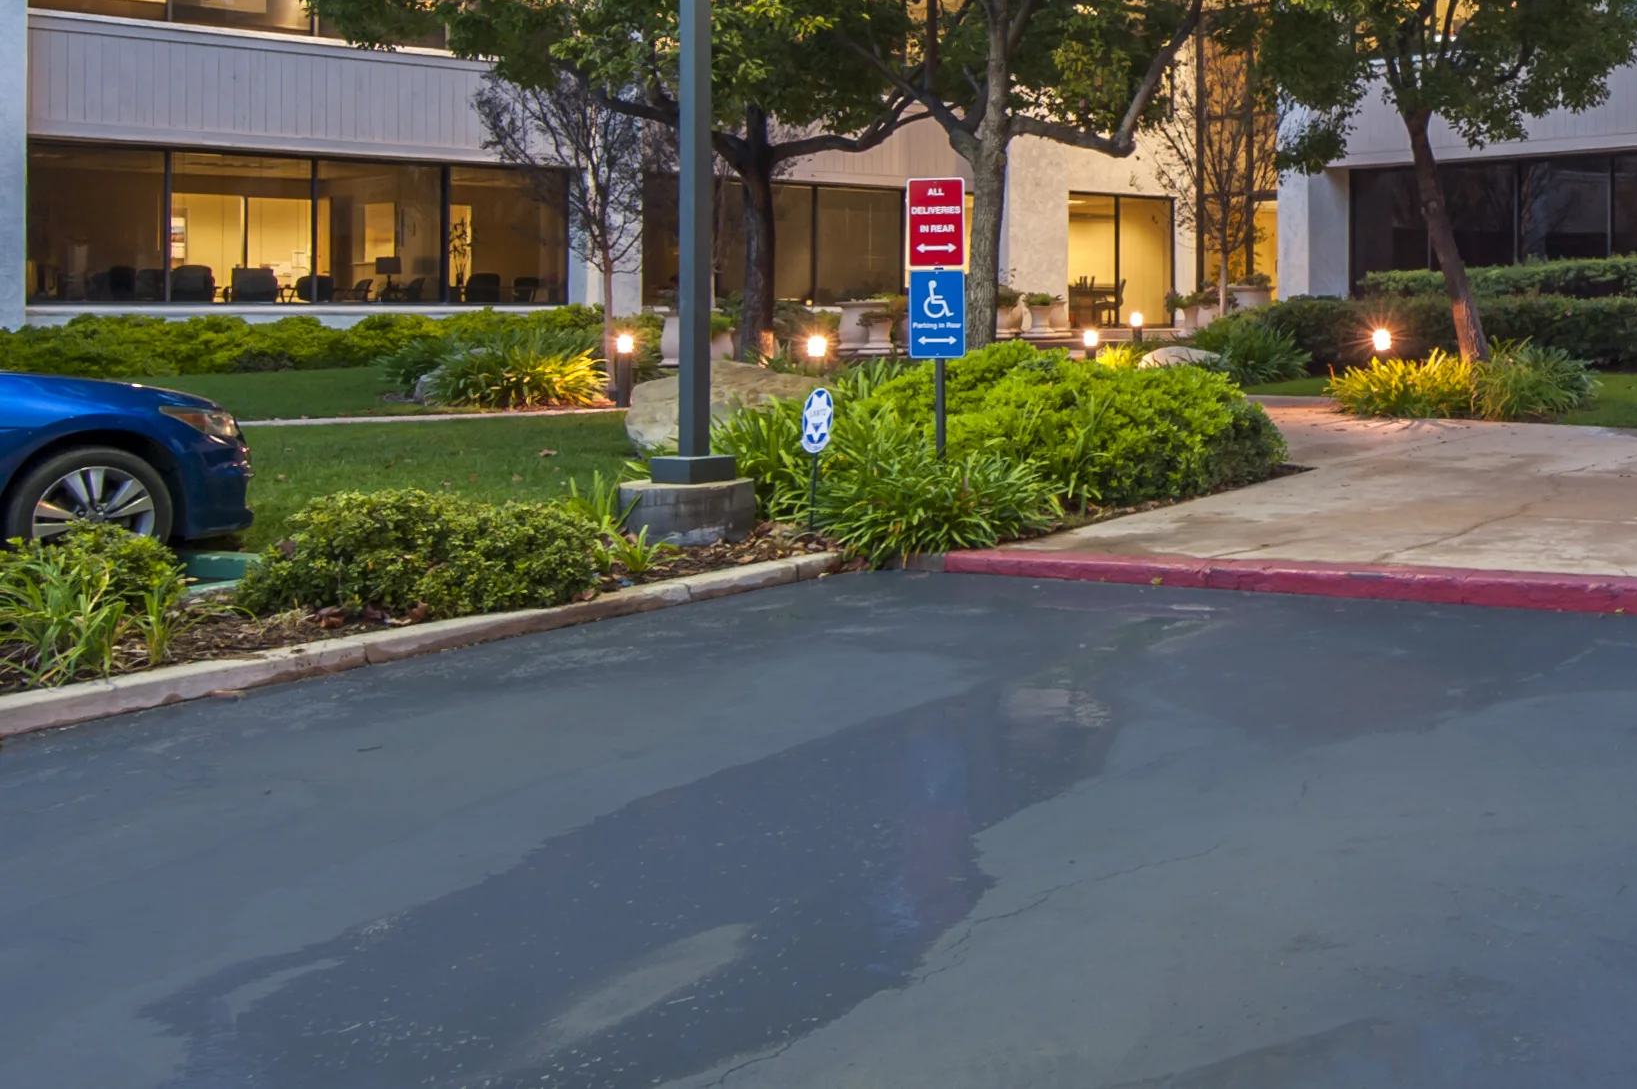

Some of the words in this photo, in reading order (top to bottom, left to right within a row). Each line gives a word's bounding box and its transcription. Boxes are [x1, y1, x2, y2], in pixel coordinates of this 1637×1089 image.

[927, 188, 944, 196] ALL
[910, 206, 961, 215] DELIVERIES
[919, 225, 929, 233] IN
[930, 225, 955, 233] REAR
[912, 321, 937, 330] Parking
[938, 321, 945, 329] in
[946, 321, 962, 329] Rear
